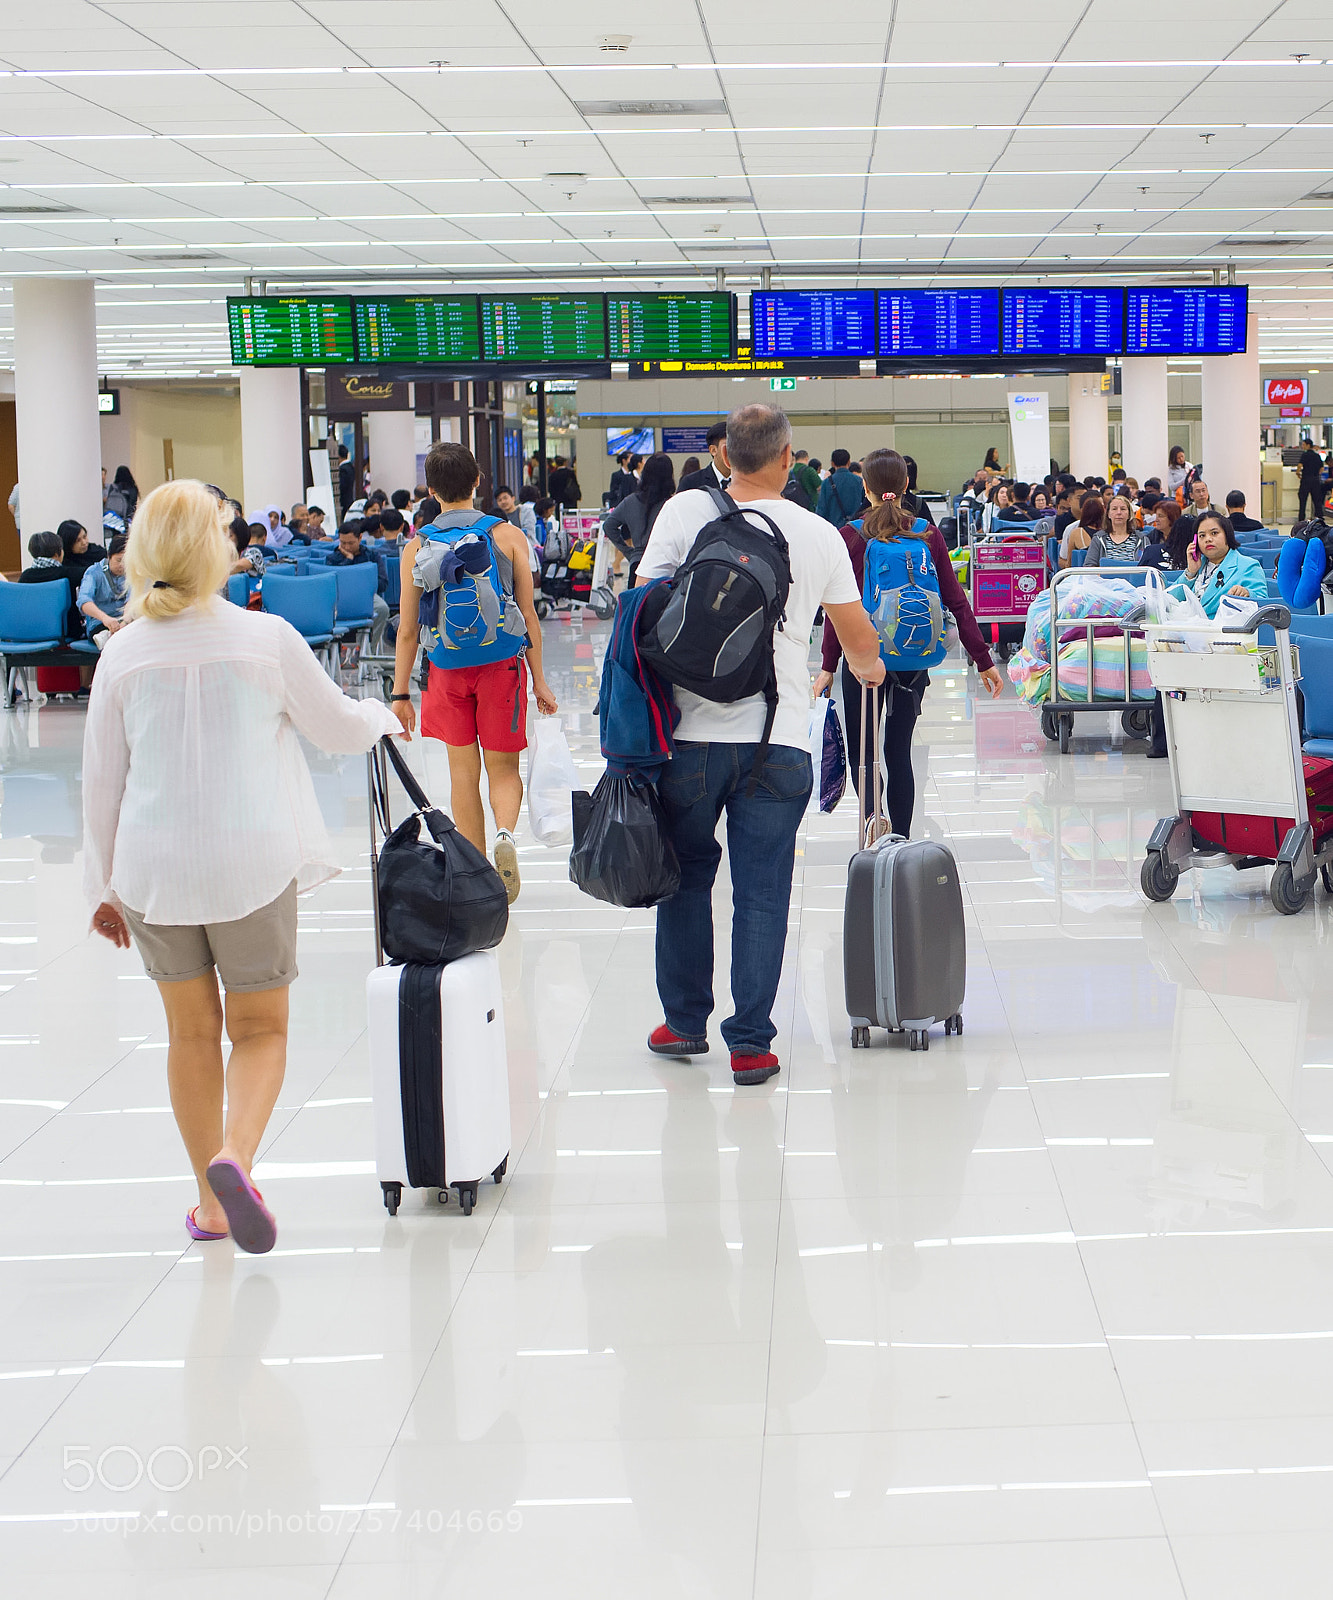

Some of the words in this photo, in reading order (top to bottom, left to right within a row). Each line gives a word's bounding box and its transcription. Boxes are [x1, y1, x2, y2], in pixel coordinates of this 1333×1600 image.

[685, 362, 715, 370] Domestic
[716, 362, 751, 372] Departures
[346, 377, 394, 394] Coral
